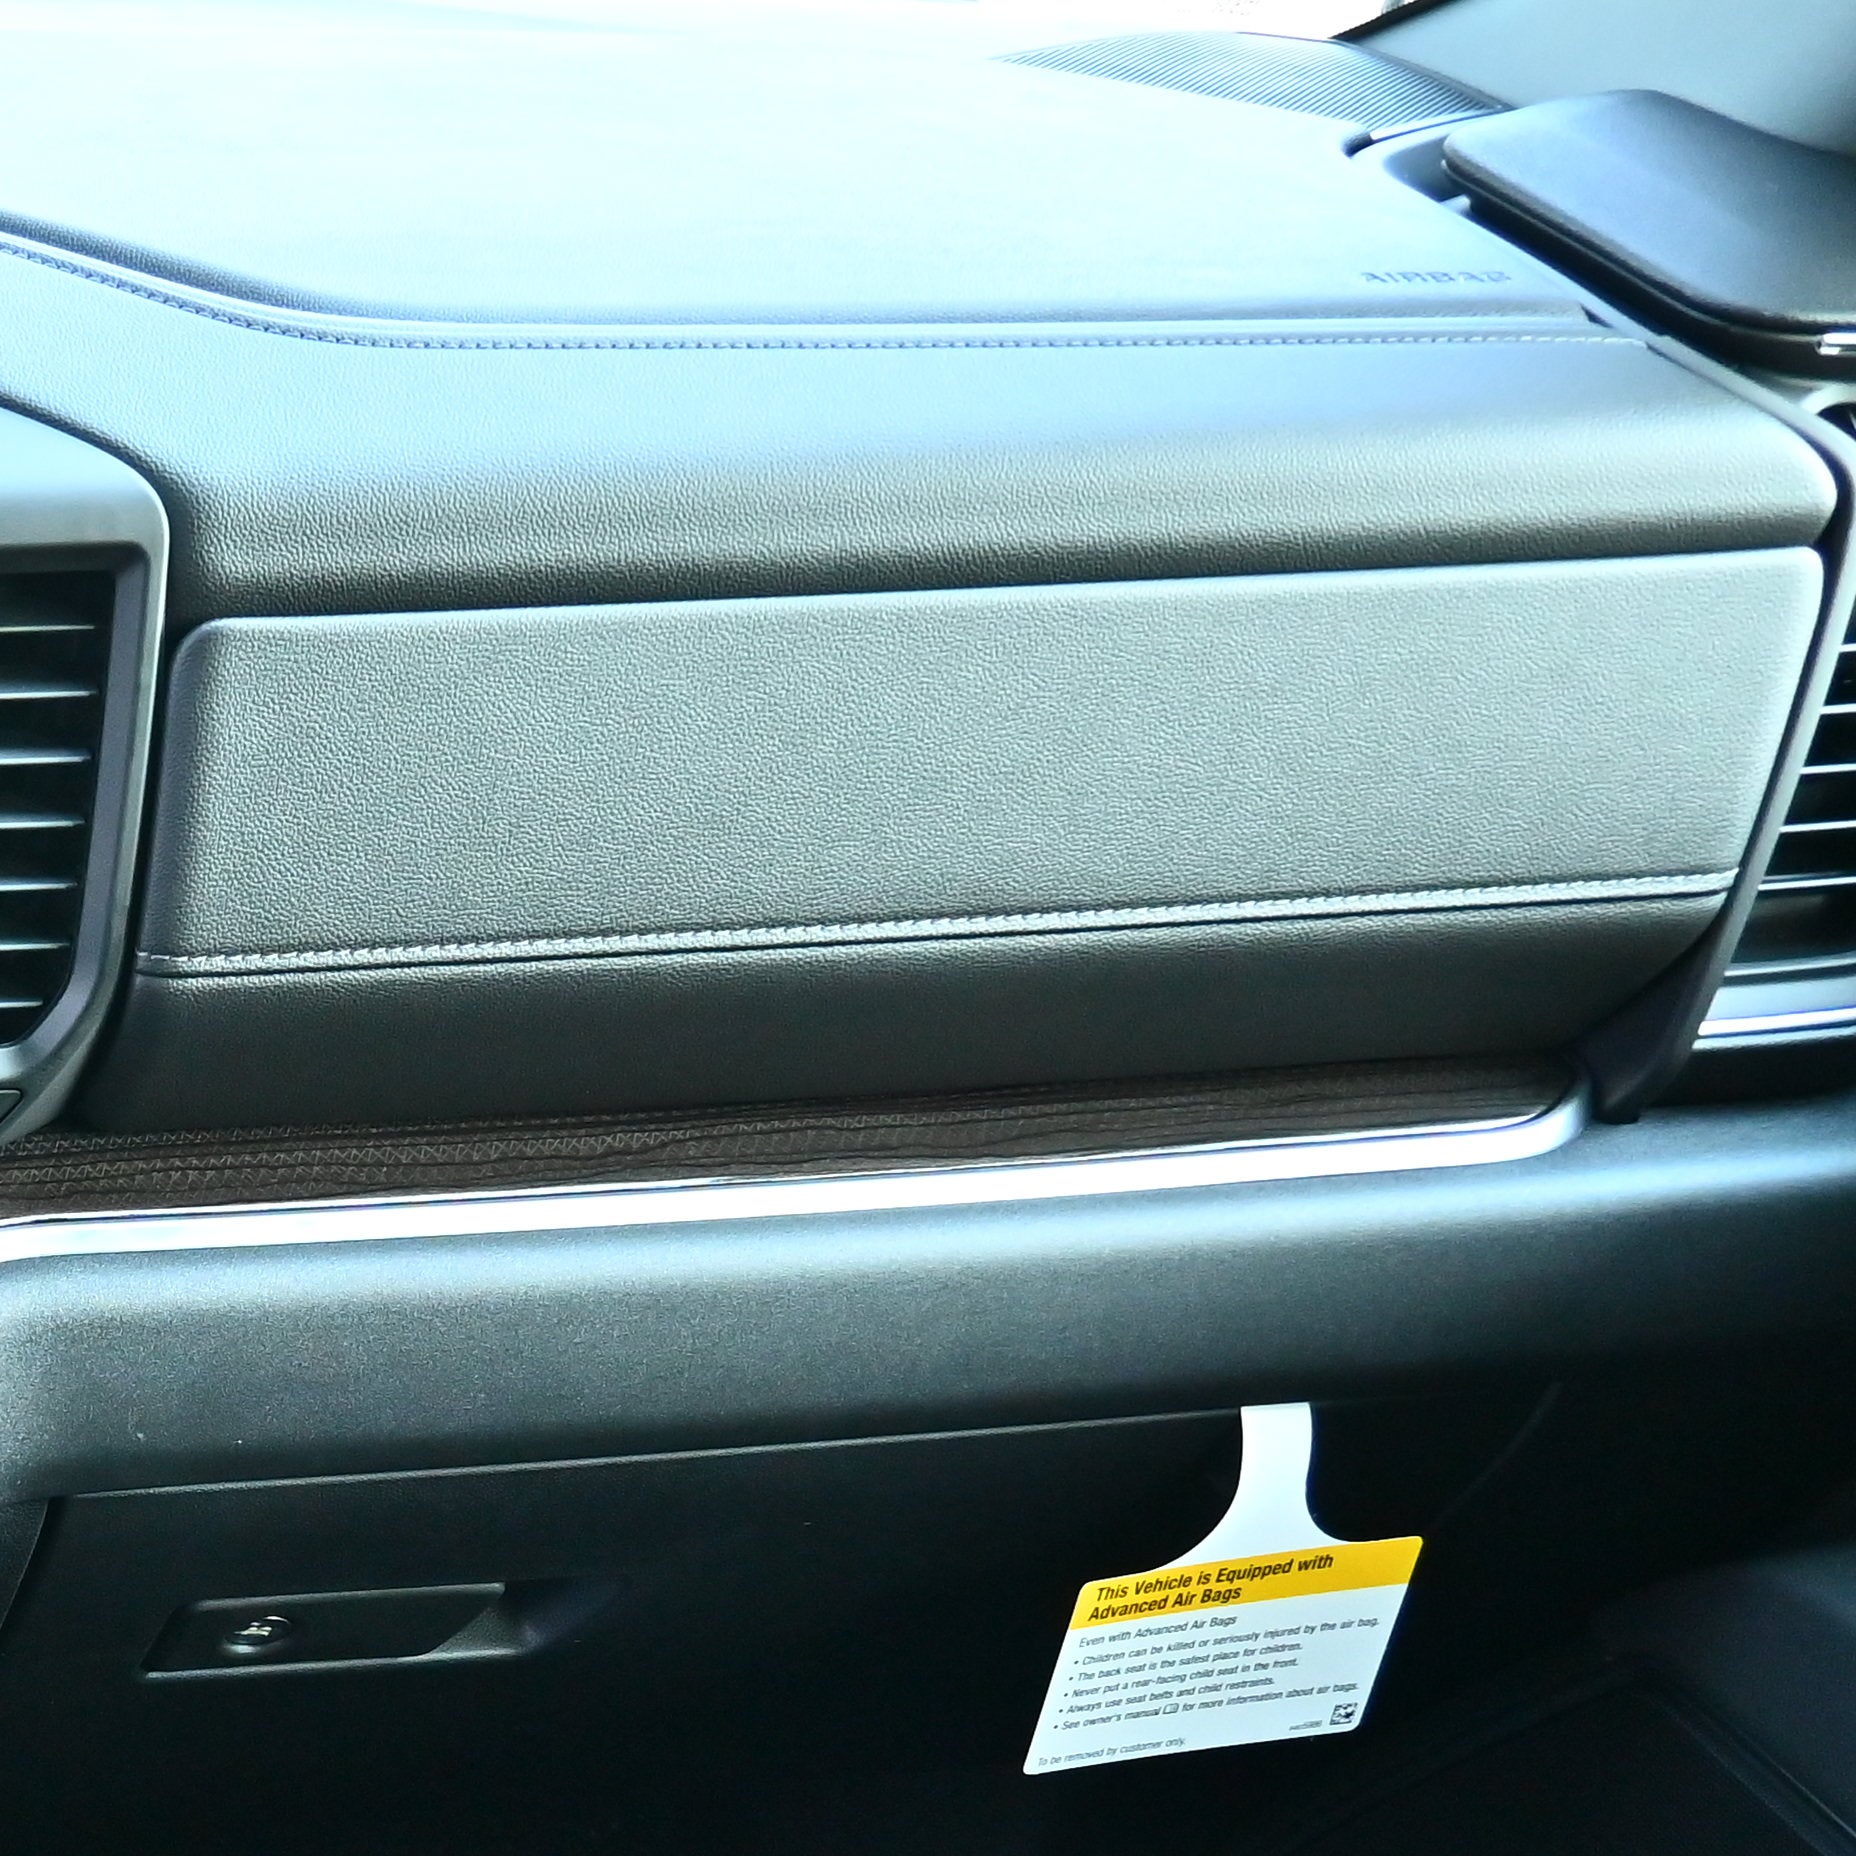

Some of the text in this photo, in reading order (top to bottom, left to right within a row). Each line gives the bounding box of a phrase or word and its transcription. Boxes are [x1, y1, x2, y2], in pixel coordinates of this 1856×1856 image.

[1360, 270, 1512, 284] AIRBAG
[1097, 1554, 1334, 1601] This Vehicle is Equipped with
[1087, 1587, 1241, 1620] Advanced Air Bags
[1079, 1616, 1237, 1647] Even with Advanced Air Bags
[1082, 1651, 1124, 1665] Children
[1128, 1649, 1146, 1657] can
[1150, 1645, 1163, 1654] be
[1166, 1640, 1195, 1651] killed
[1198, 1639, 1208, 1647] or
[1212, 1632, 1260, 1645] seriously
[1263, 1627, 1300, 1639] injured
[1303, 1625, 1316, 1633] by
[1320, 1622, 1336, 1631] the
[1340, 1619, 1354, 1629] air
[1072, 1687, 1101, 1697] Never
[1103, 1683, 1119, 1693] put
[1131, 1672, 1186, 1687] rear-facing
[1189, 1668, 1214, 1679] child
[1216, 1665, 1238, 1676] seat
[1241, 1663, 1250, 1672] in
[1253, 1661, 1269, 1671] the
[1078, 1672, 1095, 1681] The
[1098, 1667, 1120, 1677] back
[1124, 1663, 1146, 1673] seat
[1148, 1661, 1156, 1669] is
[1160, 1658, 1175, 1668] the
[1178, 1654, 1209, 1665] safest
[1211, 1650, 1239, 1661] place
[1242, 1648, 1256, 1656] for
[1061, 1721, 1079, 1730] See
[1082, 1713, 1121, 1726] owner's
[1124, 1707, 1161, 1719] manual
[1181, 1702, 1195, 1711] for
[1198, 1699, 1223, 1710] more
[1226, 1691, 1283, 1704] information
[1285, 1687, 1314, 1697] about
[1316, 1685, 1330, 1694] air
[1066, 1701, 1101, 1713] Always
[1105, 1698, 1122, 1707] use
[1125, 1694, 1146, 1704] seat
[1149, 1689, 1173, 1700] belts
[1176, 1686, 1196, 1697] and
[1197, 1683, 1223, 1694] child
[1038, 1757, 1047, 1766] To
[1049, 1755, 1061, 1764] be
[1063, 1749, 1103, 1762] removed
[1105, 1747, 1117, 1756] by
[1119, 1741, 1163, 1753] customer
